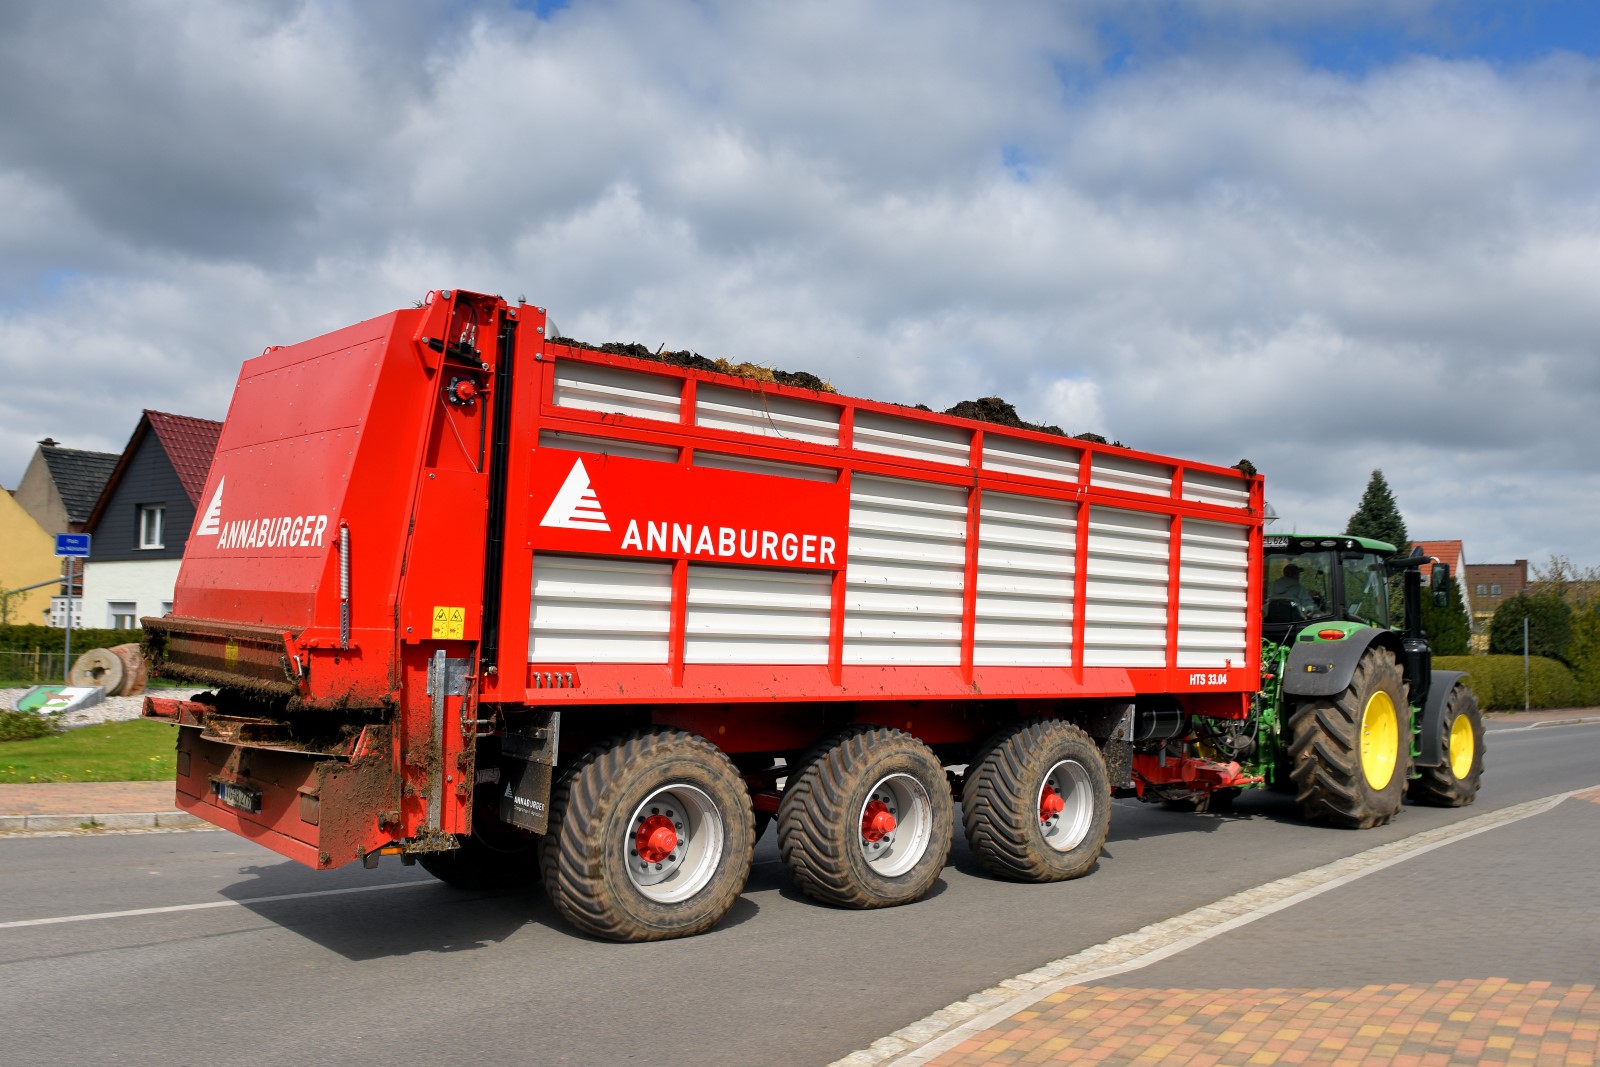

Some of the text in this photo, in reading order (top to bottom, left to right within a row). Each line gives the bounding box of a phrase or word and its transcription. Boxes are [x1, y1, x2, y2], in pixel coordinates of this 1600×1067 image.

[217, 515, 328, 549] ANNABURGER
[621, 519, 836, 564] ANNABURGER
[1189, 673, 1227, 686] HTS 33.04
